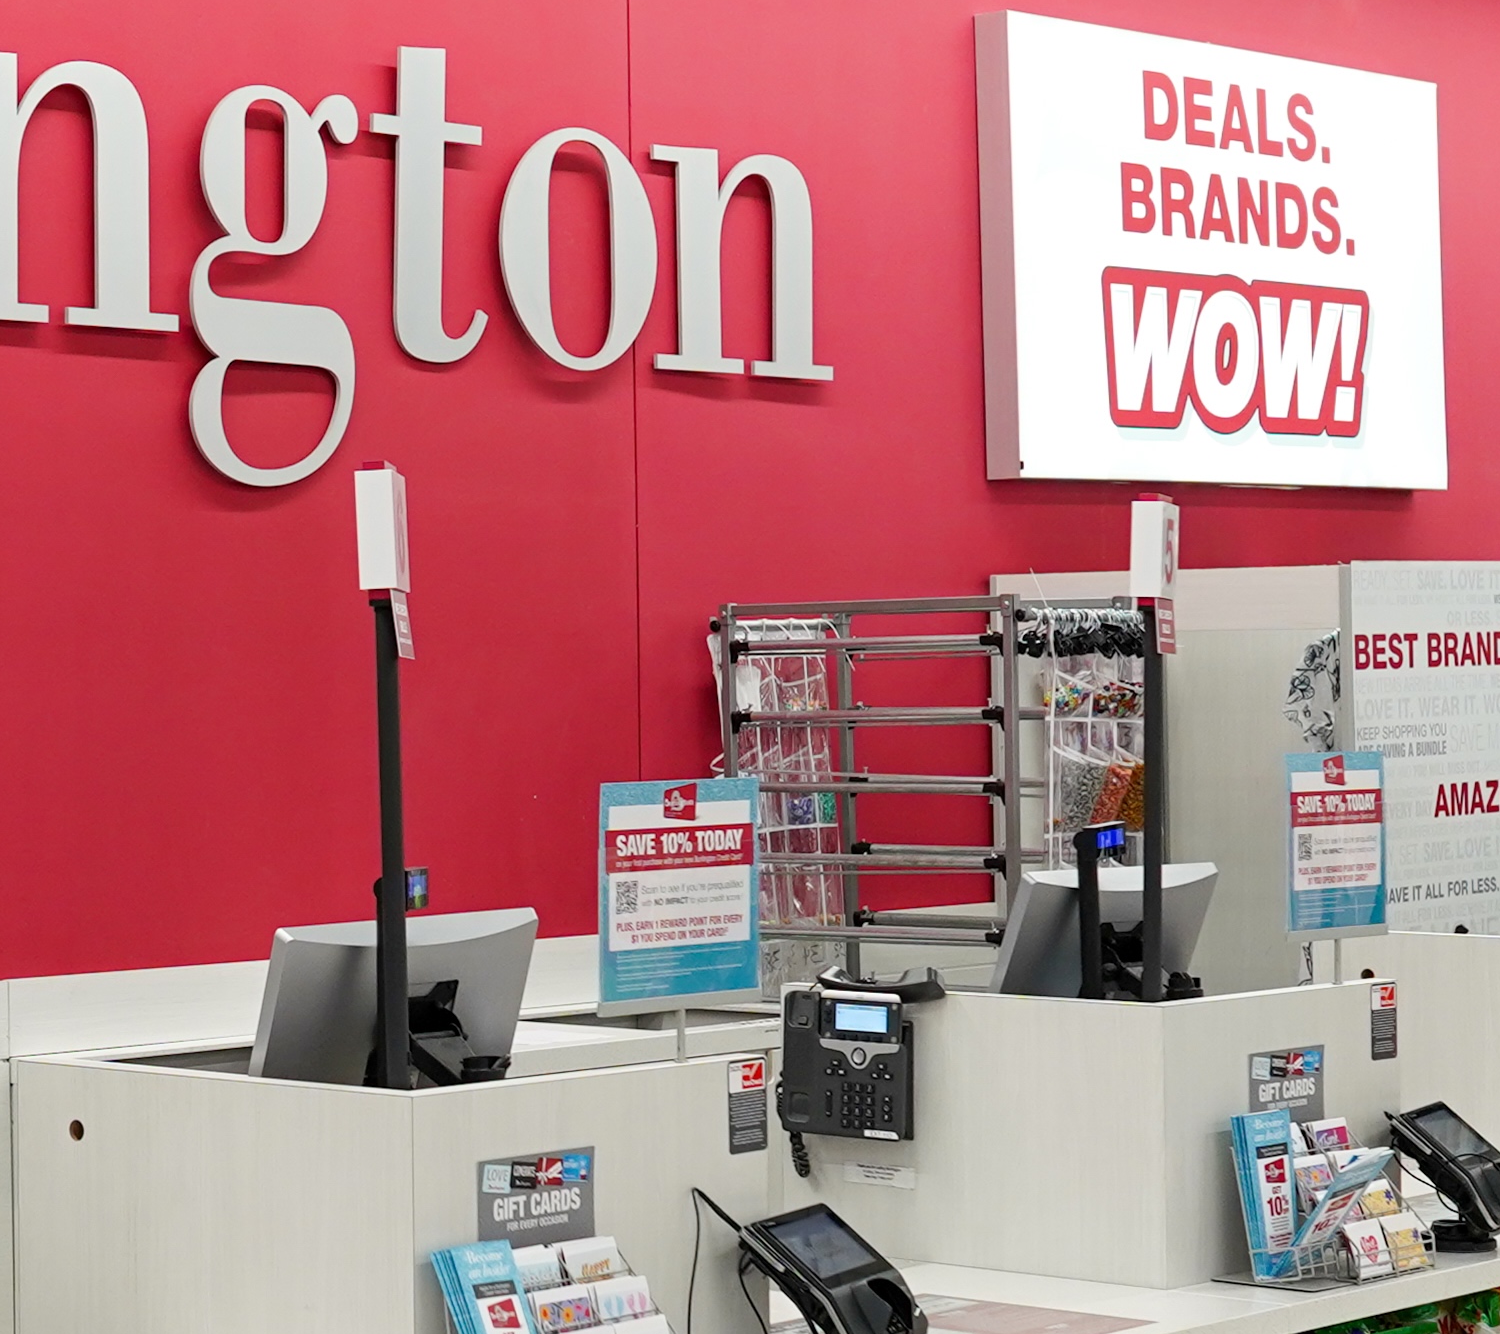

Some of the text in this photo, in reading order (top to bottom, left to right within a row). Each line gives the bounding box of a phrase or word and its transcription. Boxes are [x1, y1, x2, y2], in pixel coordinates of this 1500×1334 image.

[1143, 71, 1330, 163] DEALS.
[1121, 162, 1355, 255] BRANDS.
[1107, 281, 1364, 424] WOW!
[1354, 633, 1418, 670] BEST
[1357, 723, 1447, 741] KEEP SHOPPING YOU
[1416, 741, 1447, 756] BUNDLE
[1297, 793, 1376, 814] SAVE 10% TODAY
[616, 828, 743, 857] SAVE 10% TODAY
[1413, 877, 1500, 901] IT ALL FOR LESS.
[709, 915, 722, 926] FOR
[723, 914, 743, 925] EVERY
[1258, 1077, 1315, 1103] GIFT CARDS
[487, 1169, 508, 1183] LOVE
[493, 1187, 581, 1222] GIFT CARDS
[506, 1221, 518, 1231] FOR
[520, 1218, 538, 1229] EVERY
